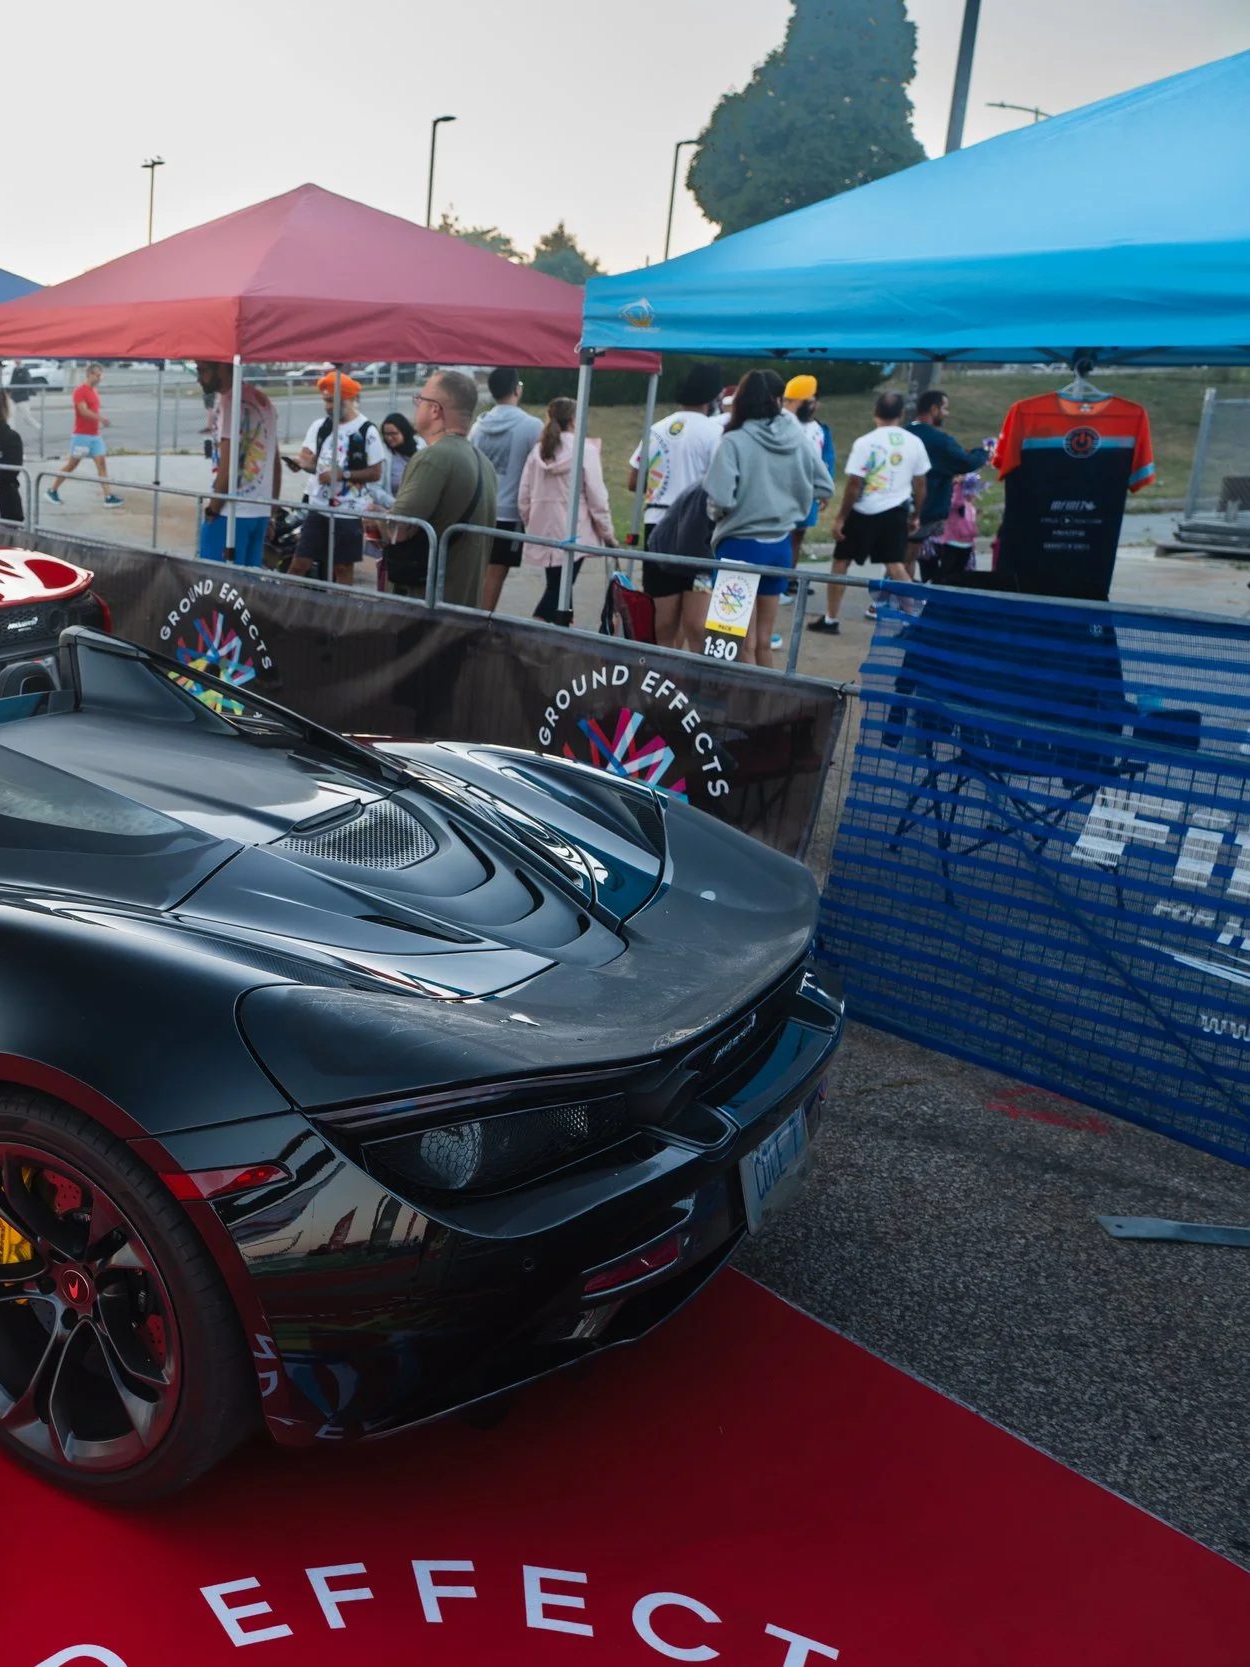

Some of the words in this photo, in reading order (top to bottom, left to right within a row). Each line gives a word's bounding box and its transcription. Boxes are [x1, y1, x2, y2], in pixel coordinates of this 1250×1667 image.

[160, 579, 213, 640] GROUND
[219, 583, 272, 669] EFFECTS
[704, 636, 738, 661] 1:30
[538, 665, 629, 746] GROUND
[641, 670, 729, 797] EFFECTS
[200, 1559, 840, 1667] EFFECT
